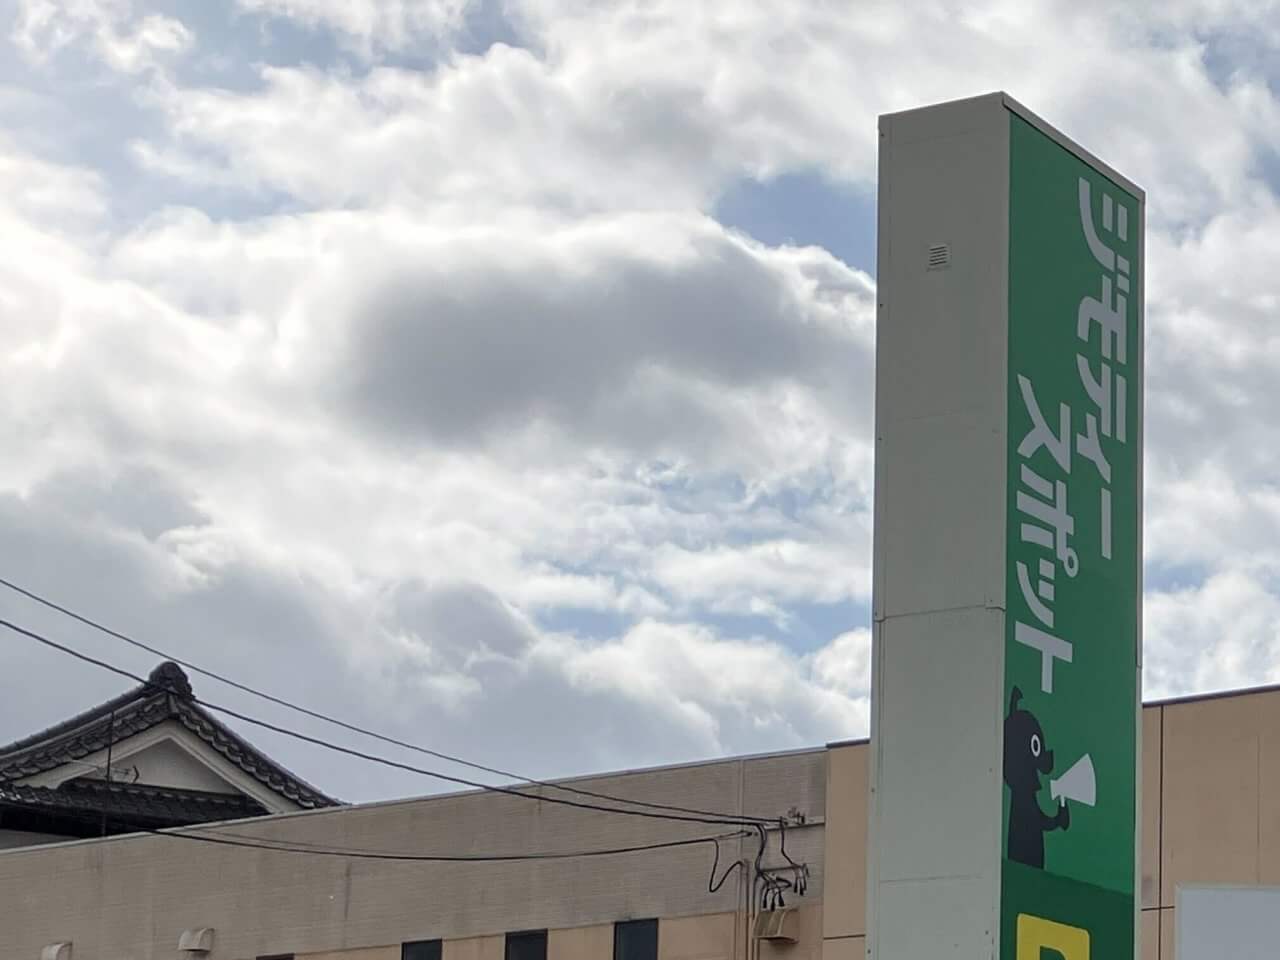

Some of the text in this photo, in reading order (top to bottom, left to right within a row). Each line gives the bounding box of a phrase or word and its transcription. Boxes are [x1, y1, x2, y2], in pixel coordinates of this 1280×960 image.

[1015, 373, 1079, 694] スポット
[1076, 176, 1130, 560] ジモティー
